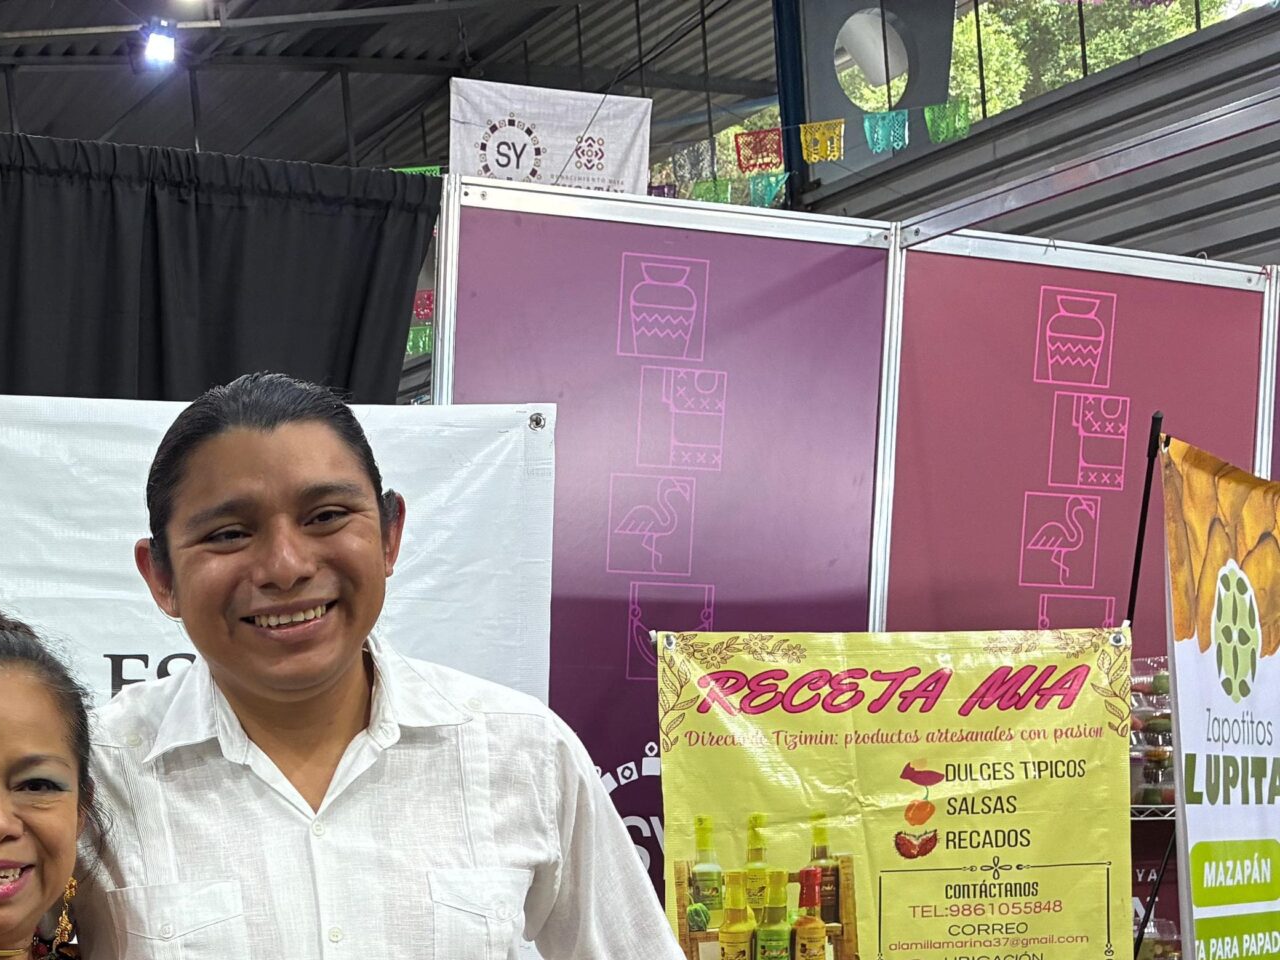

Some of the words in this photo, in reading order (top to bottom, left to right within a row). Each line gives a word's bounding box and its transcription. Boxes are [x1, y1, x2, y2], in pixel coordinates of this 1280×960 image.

[495, 140, 526, 170] SY
[696, 667, 953, 716] RECETA
[958, 664, 1091, 717] MIA
[772, 730, 838, 750] Tizimin:
[844, 729, 920, 749] productos
[926, 726, 1014, 743] artesanales
[1020, 728, 1047, 740] con
[1054, 724, 1104, 743] pasion
[1206, 707, 1273, 751] Zapotitos
[944, 762, 1015, 782] DULCES
[946, 796, 1017, 815] SALSAS
[945, 829, 1031, 850] RECADOS
[1136, 868, 1158, 882] YA
[1203, 852, 1270, 888] MAZAPÁN
[908, 900, 1063, 918] TEL:9861055848
[948, 922, 1028, 937] CORREO
[888, 934, 1089, 951] alamillamarina37@gmail.com
